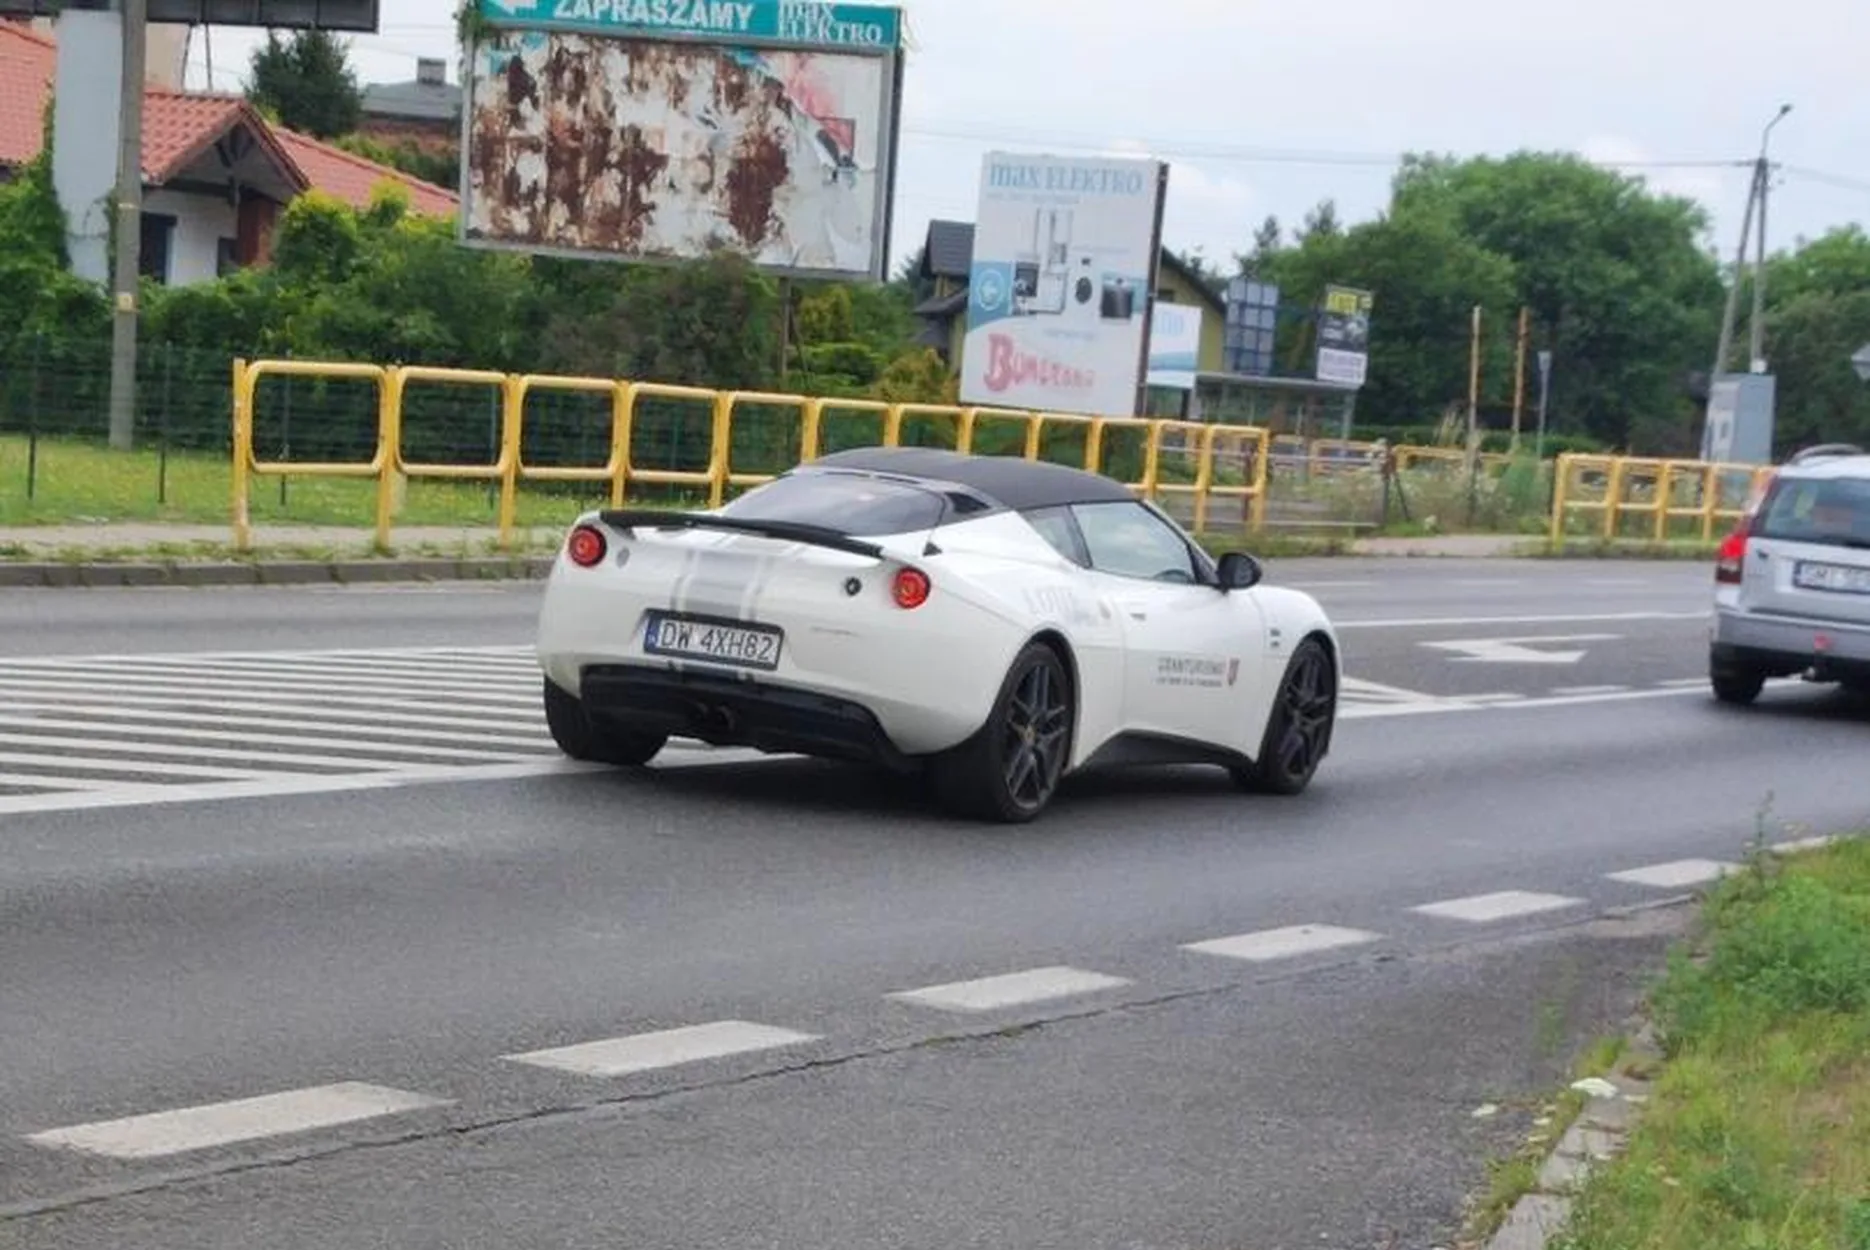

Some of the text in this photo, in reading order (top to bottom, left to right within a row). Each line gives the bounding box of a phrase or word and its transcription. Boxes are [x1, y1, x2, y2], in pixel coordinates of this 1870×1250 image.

[553, 0, 755, 31] ZAPRASZAMY
[778, 16, 883, 45] ELEKTRO
[1045, 165, 1144, 195] ELEKTRO
[661, 622, 774, 661] DW 4XH82
